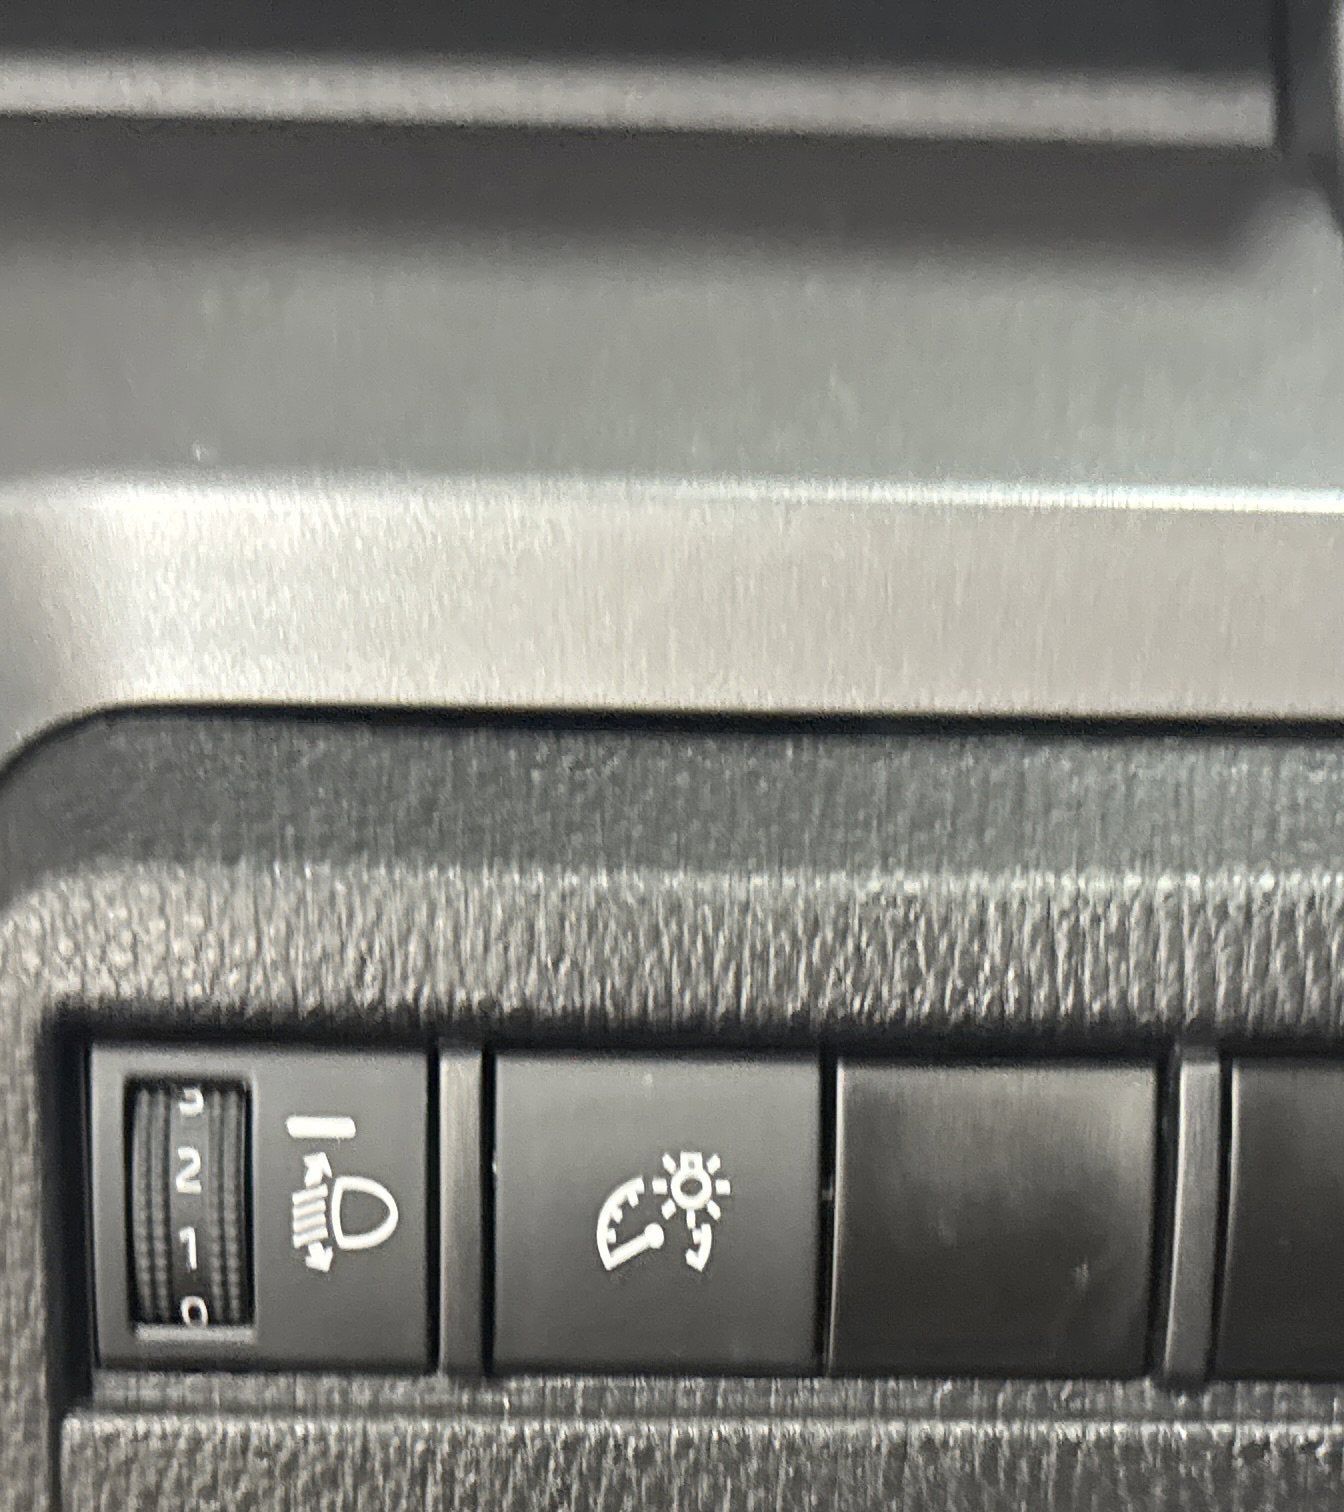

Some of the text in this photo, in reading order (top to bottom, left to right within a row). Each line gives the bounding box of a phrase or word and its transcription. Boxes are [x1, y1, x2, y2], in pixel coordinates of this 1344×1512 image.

[176, 1147, 202, 1194] 2
[179, 1226, 197, 1270] 1
[180, 1296, 208, 1327] 0
